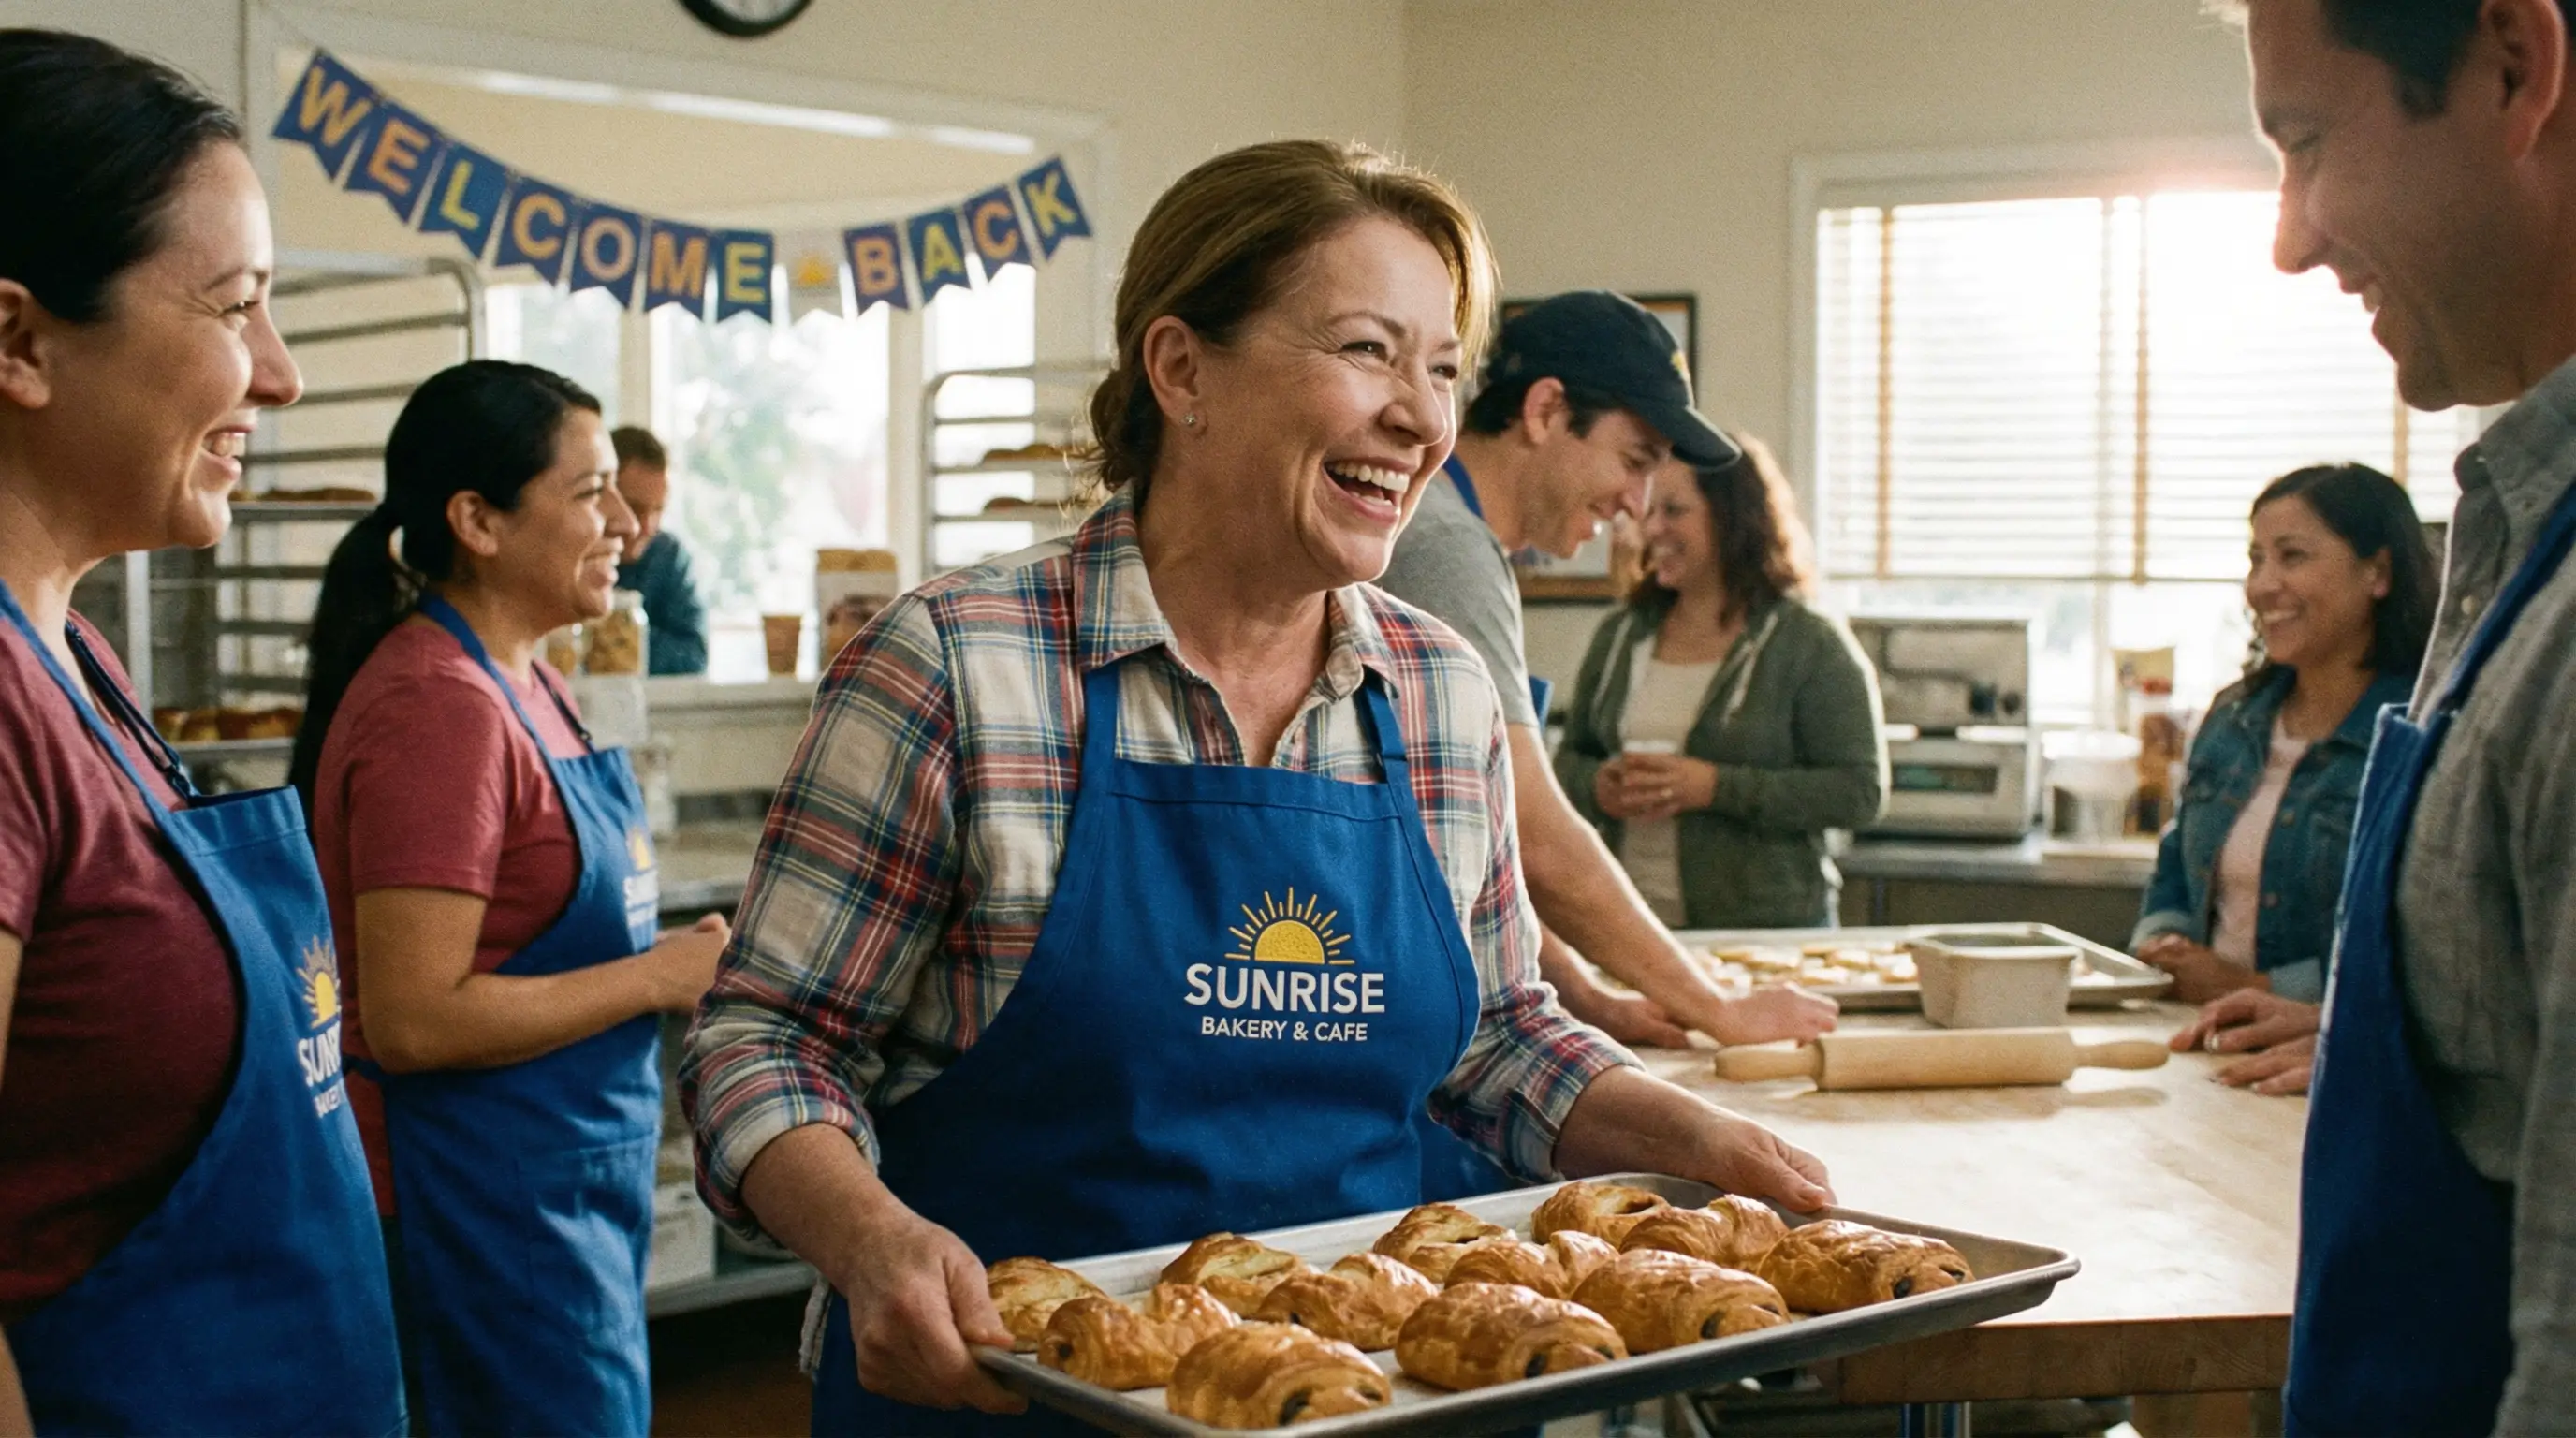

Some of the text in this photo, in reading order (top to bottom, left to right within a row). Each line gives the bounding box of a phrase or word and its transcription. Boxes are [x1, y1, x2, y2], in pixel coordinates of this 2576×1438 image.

[299, 65, 1076, 304] WELCOME BACK
[1184, 963, 1385, 1013] SUNRISE
[1201, 1016, 1368, 1041] BAKERY & CAFE
